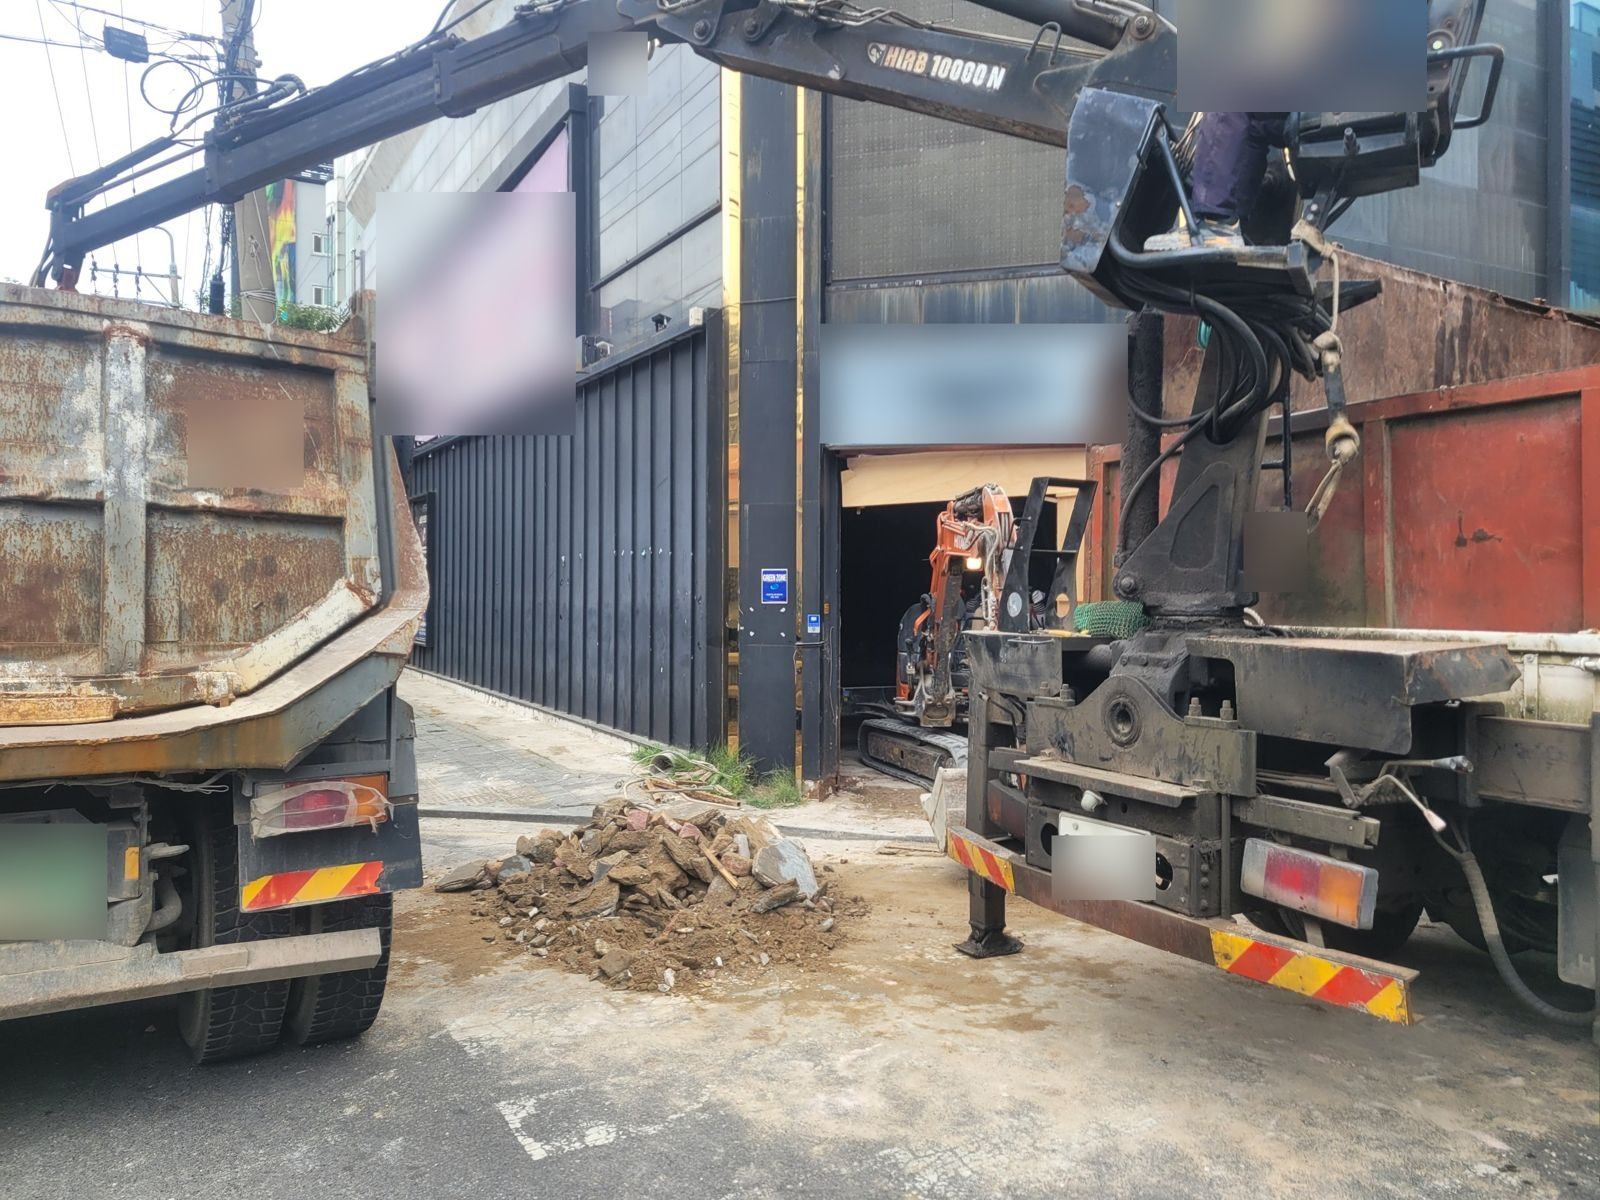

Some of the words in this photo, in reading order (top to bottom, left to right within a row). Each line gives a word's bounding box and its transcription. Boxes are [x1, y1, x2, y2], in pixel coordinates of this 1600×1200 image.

[884, 46, 928, 74] HIAB
[930, 54, 986, 87] 10000
[986, 65, 1006, 90] N
